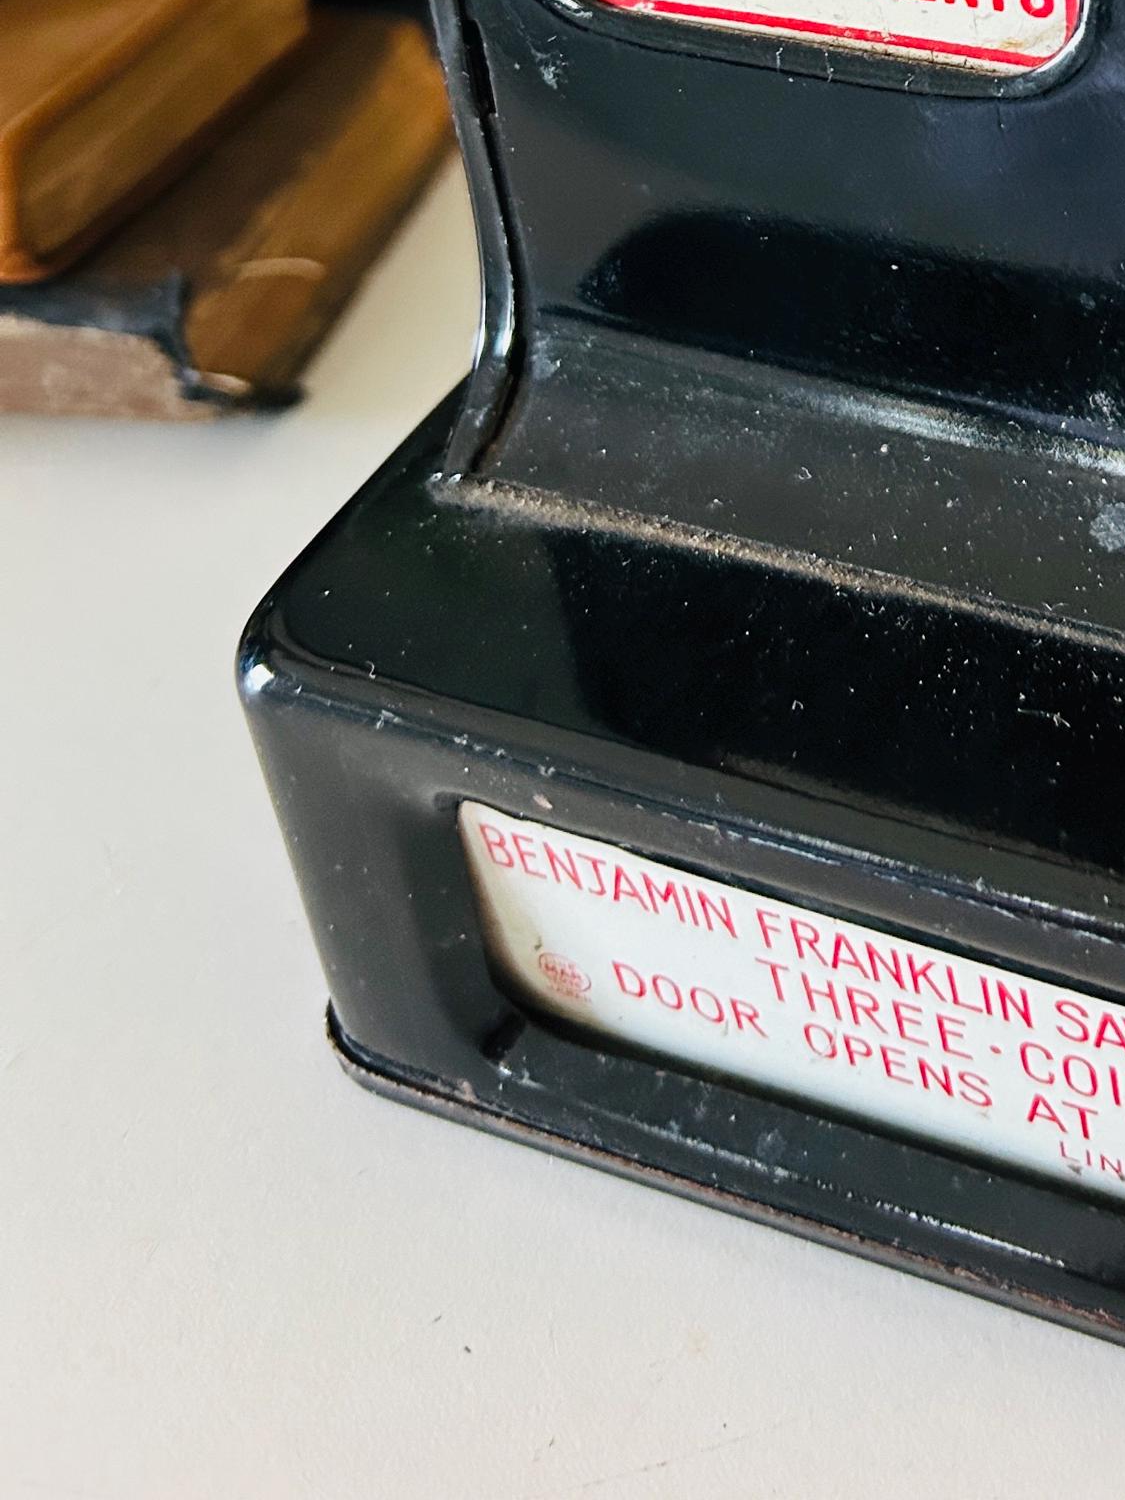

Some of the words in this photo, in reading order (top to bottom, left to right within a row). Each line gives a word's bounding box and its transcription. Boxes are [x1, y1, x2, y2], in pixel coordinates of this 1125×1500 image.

[478, 822, 738, 940] BENJAMIN
[754, 907, 1035, 1030] FRANKLIN
[611, 960, 768, 1039] DOOR
[802, 1022, 994, 1108] OPENS
[1026, 1092, 1099, 1141] AT
